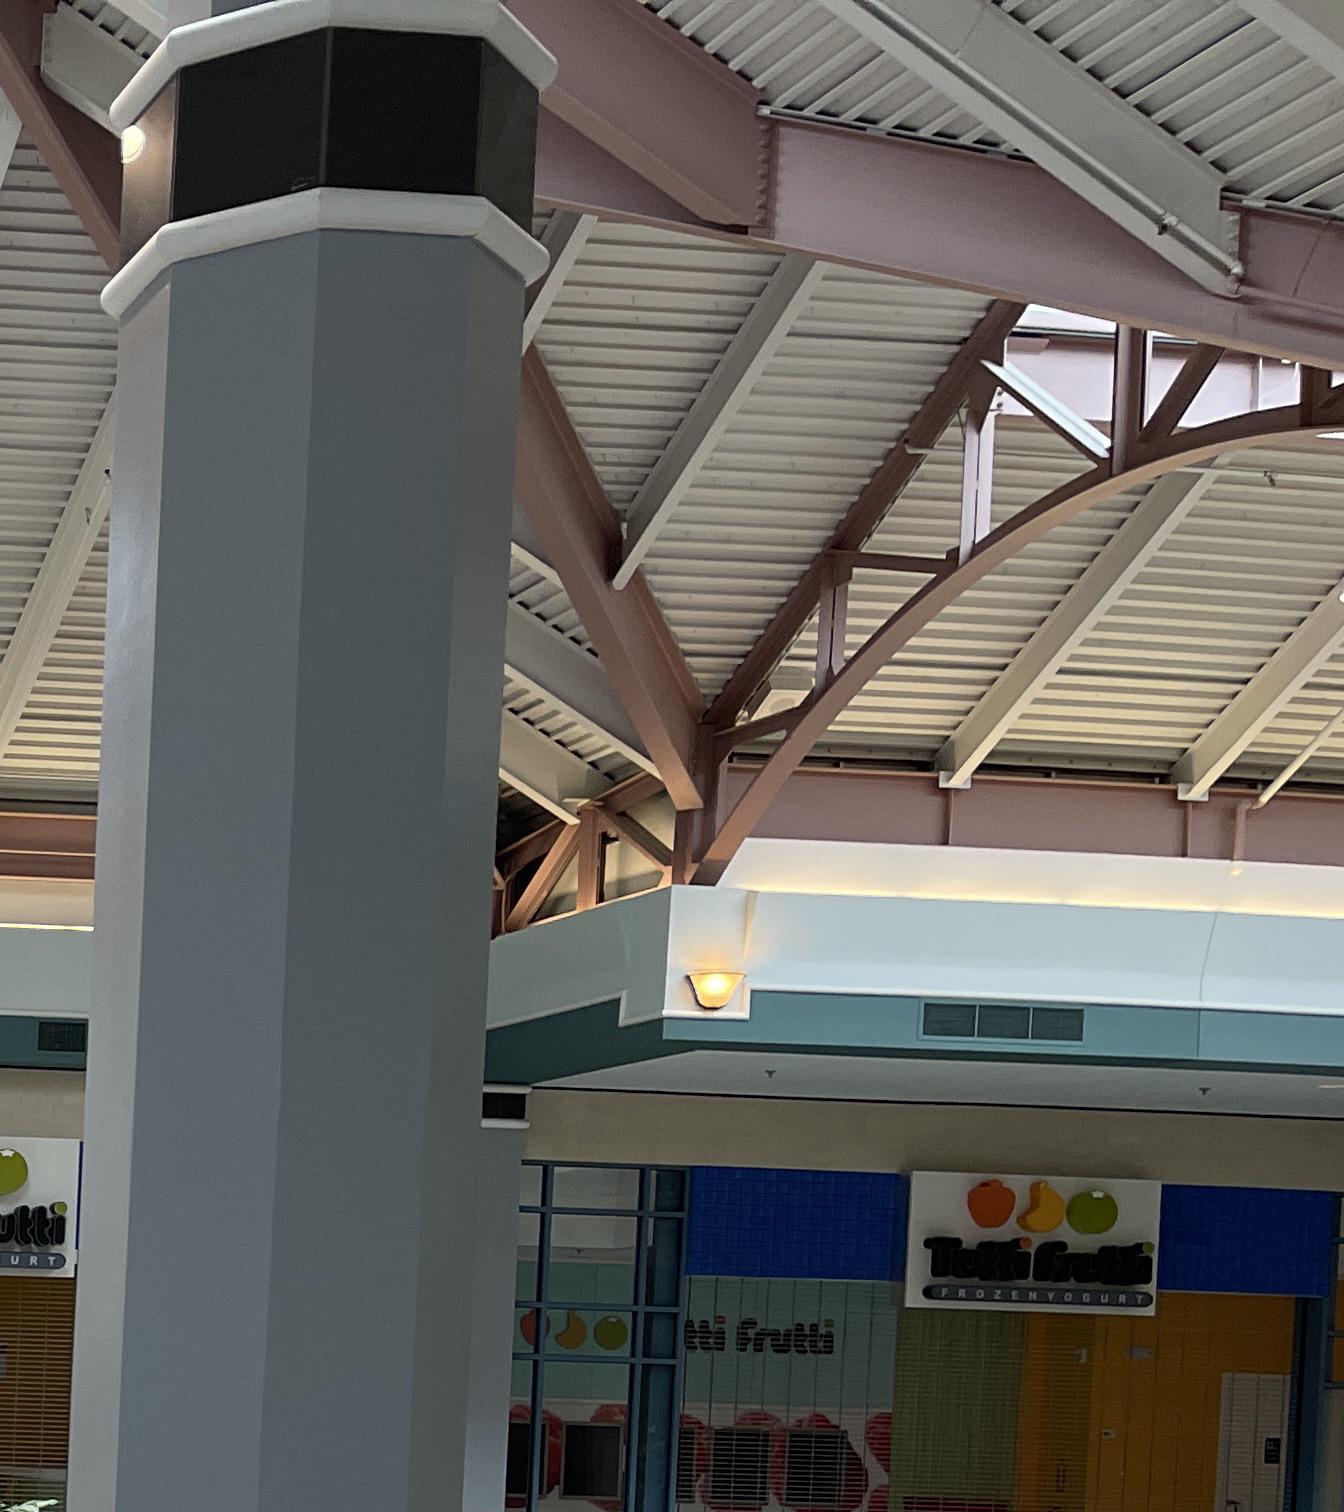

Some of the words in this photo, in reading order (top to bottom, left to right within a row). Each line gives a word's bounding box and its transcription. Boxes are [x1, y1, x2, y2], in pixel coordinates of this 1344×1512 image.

[923, 1236, 1033, 1282] Tutti
[1032, 1240, 1155, 1287] Frutti
[684, 1315, 726, 1353] tti
[736, 1318, 835, 1355] Frutti
